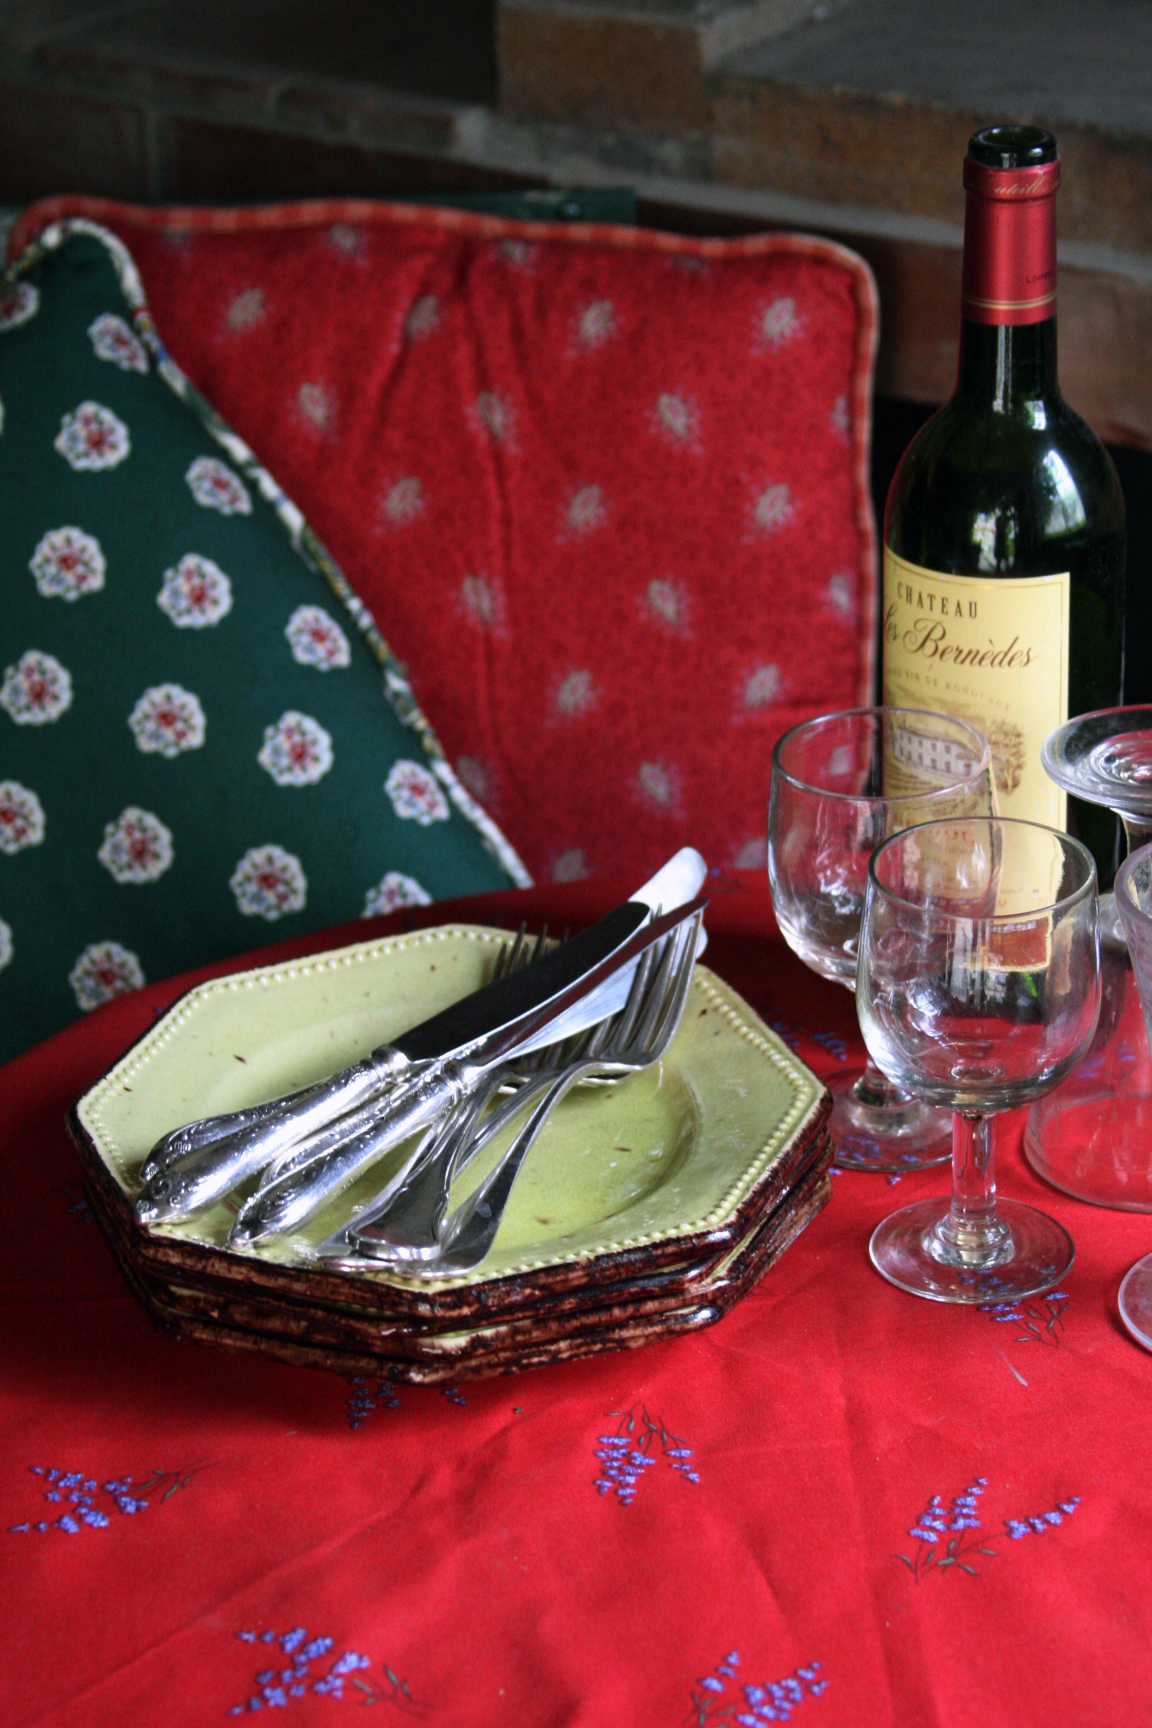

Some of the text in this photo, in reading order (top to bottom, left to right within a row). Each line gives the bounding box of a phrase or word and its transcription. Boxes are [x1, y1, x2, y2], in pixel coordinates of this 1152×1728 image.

[897, 581, 979, 618] CHATEAU
[903, 617, 1039, 668] Bernèdes
[925, 675, 938, 687] DE
